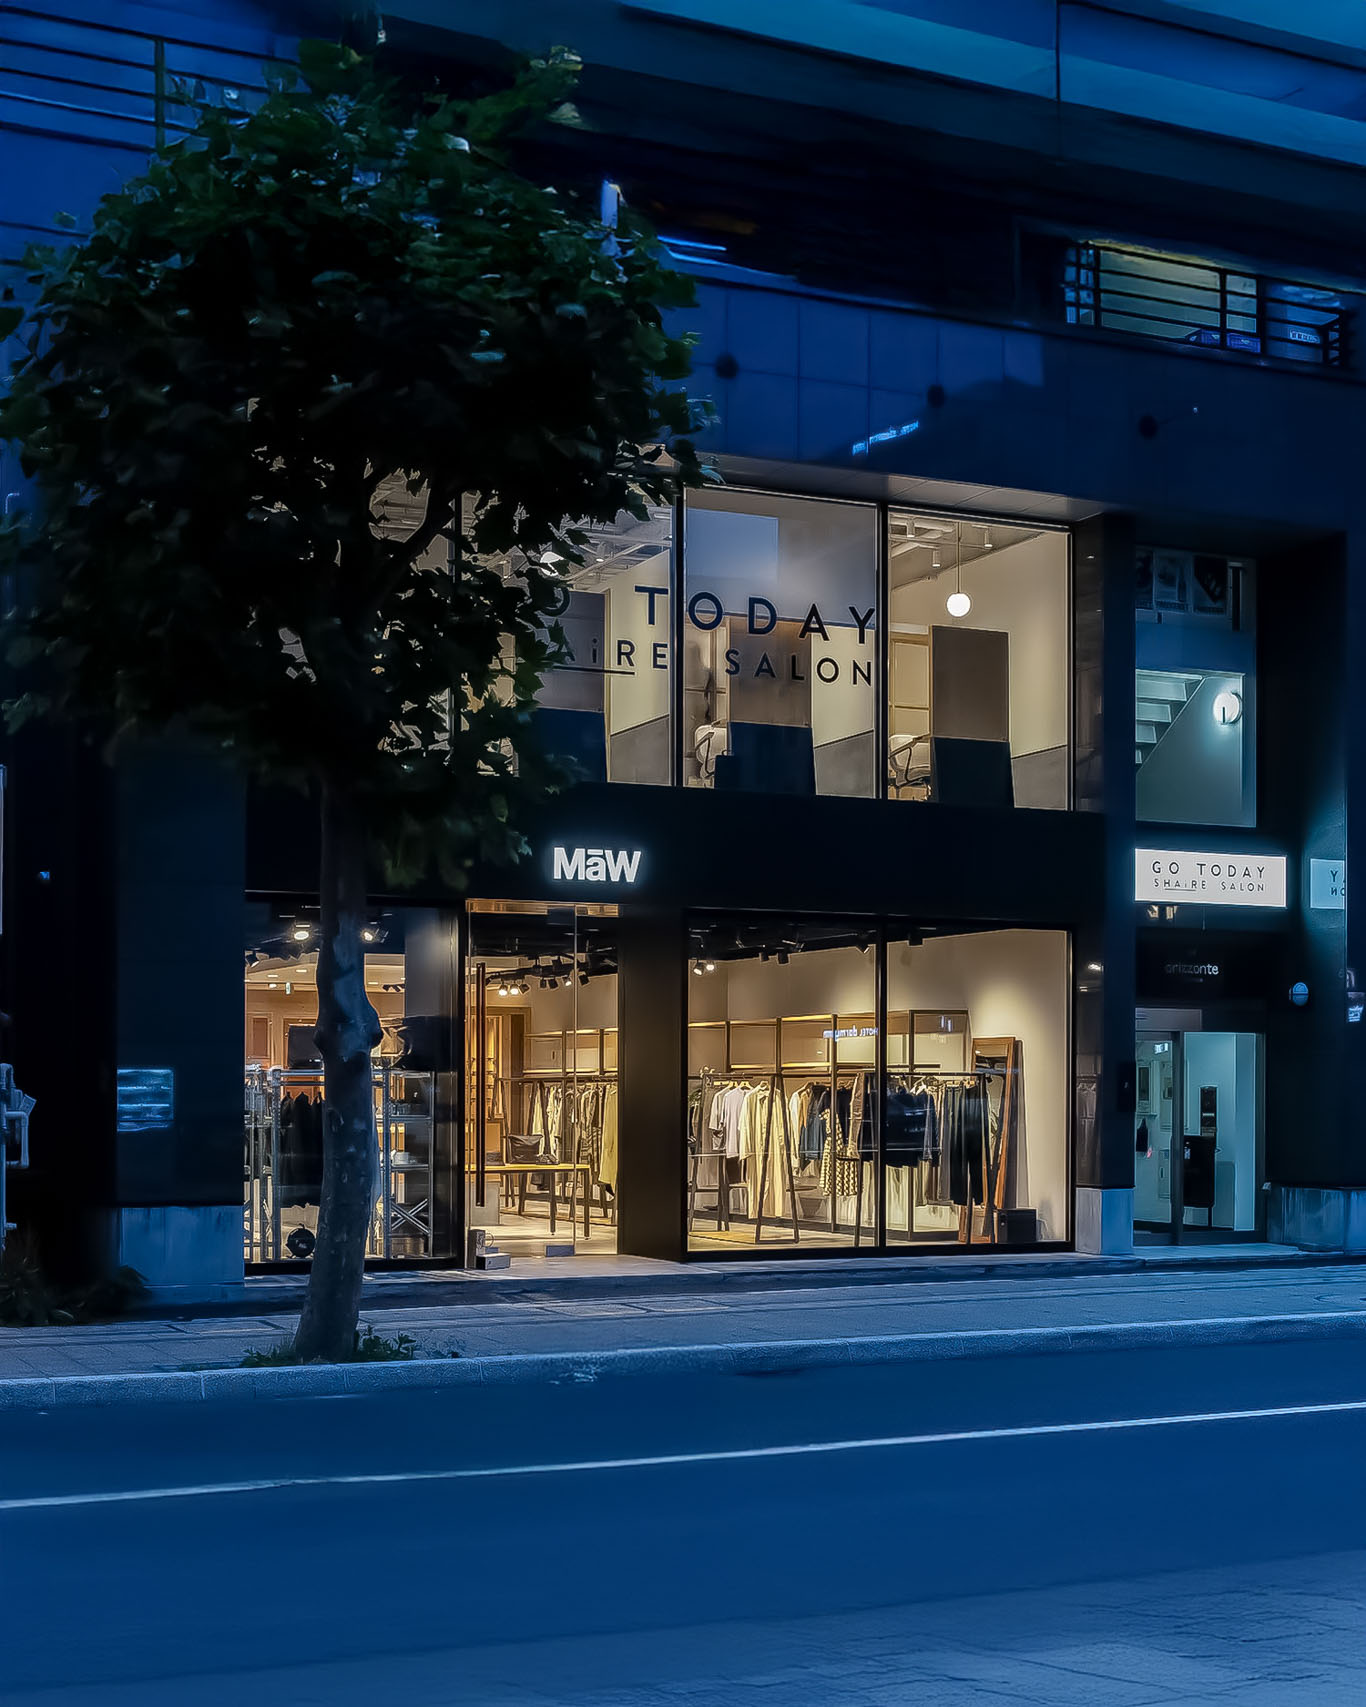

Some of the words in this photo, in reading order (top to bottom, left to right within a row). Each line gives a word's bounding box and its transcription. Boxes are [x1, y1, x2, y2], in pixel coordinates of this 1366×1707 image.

[634, 585, 876, 644] TODAY
[725, 648, 872, 686] SALON
[1152, 861, 1180, 875] GO
[1196, 863, 1265, 879] TODAY
[1220, 881, 1264, 892] SALON
